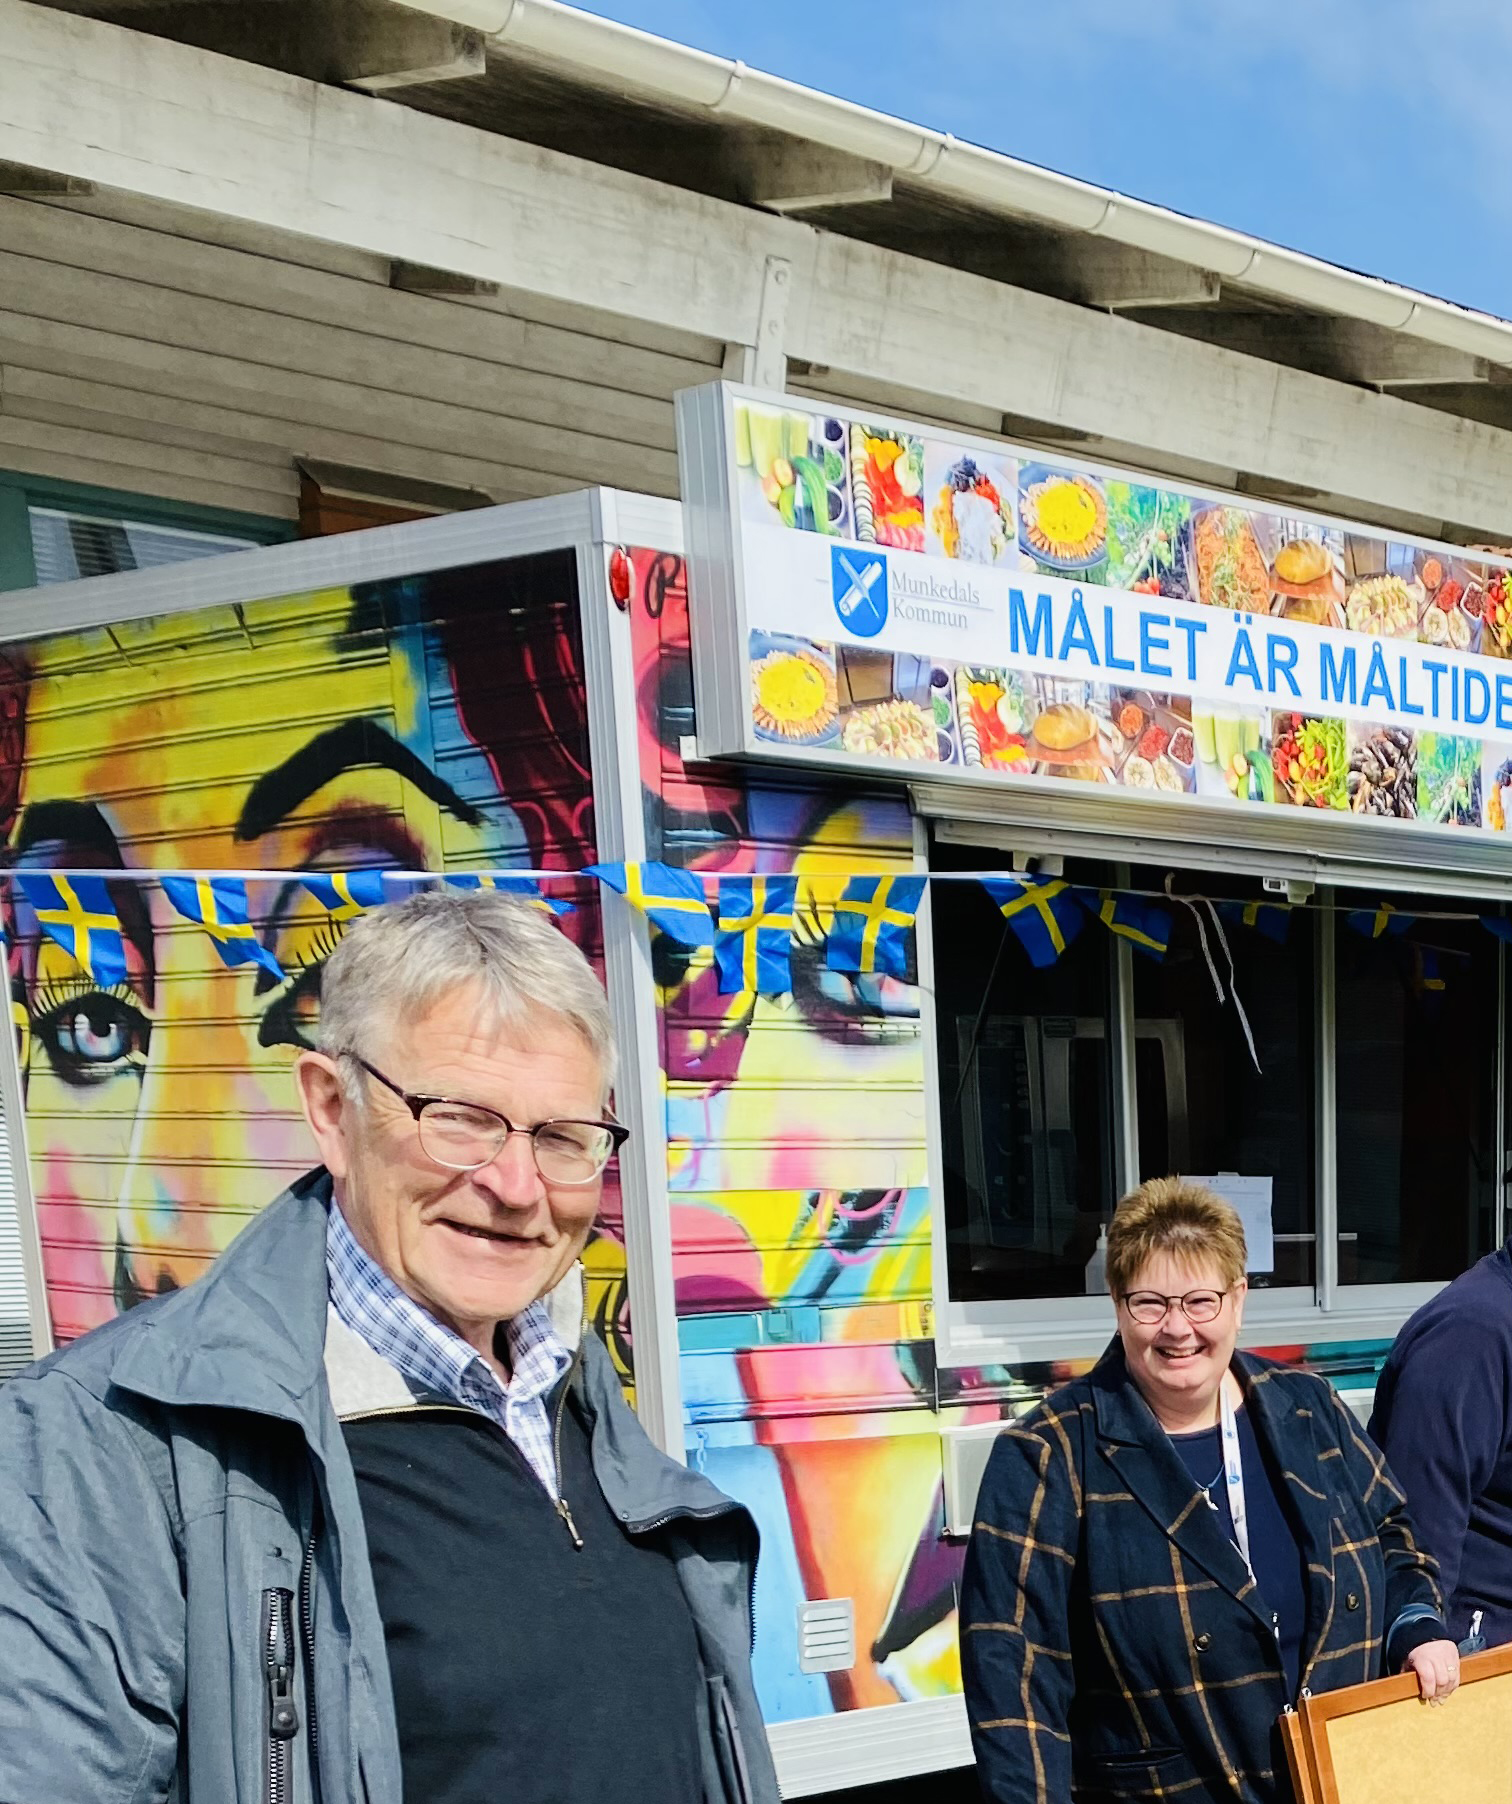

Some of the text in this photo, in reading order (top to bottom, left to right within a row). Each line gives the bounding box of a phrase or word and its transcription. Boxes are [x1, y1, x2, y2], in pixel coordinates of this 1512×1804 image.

[892, 570, 981, 605] Munkedals
[892, 597, 969, 629] Kommun
[1007, 587, 1207, 682] MÅLET
[1224, 612, 1303, 698] ÄR
